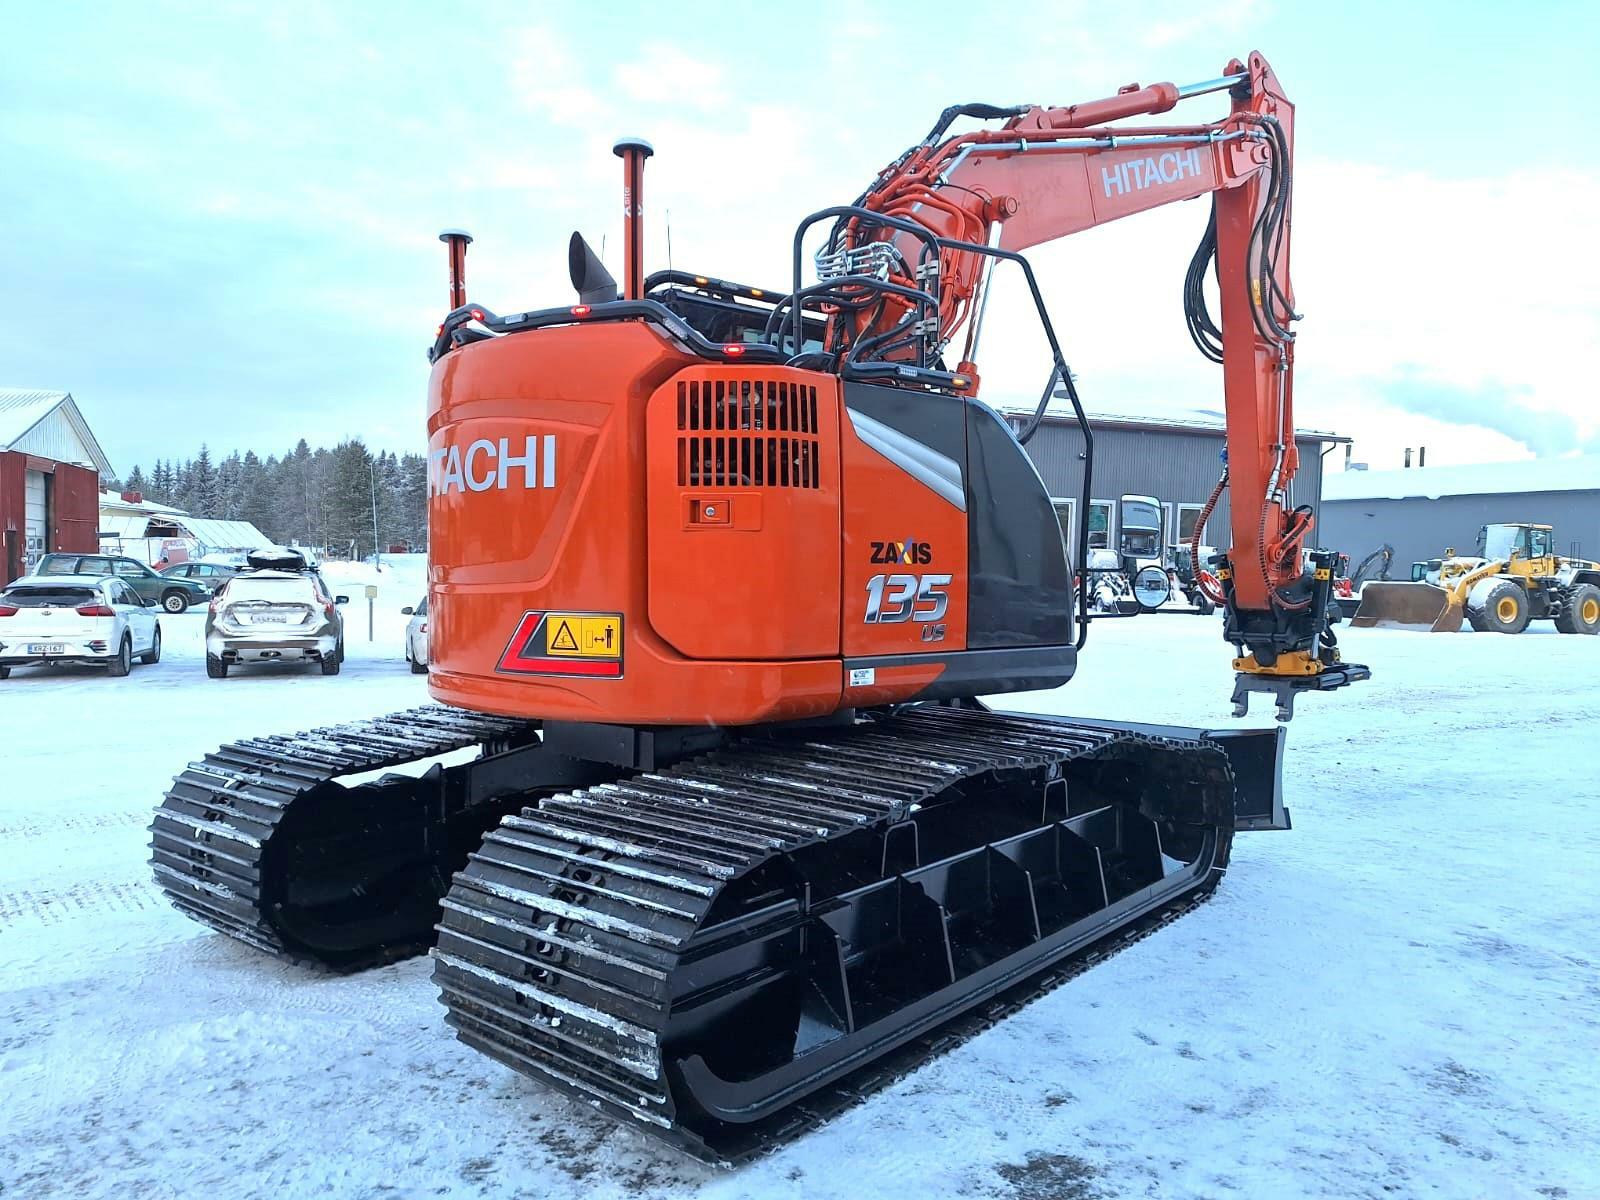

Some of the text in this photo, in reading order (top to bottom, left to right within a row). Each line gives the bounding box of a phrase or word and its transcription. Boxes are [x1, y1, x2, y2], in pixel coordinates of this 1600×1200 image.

[1101, 149, 1202, 198] HITACHI
[870, 537, 932, 565] ZAXIS
[864, 573, 953, 624] 135
[921, 623, 947, 642] US
